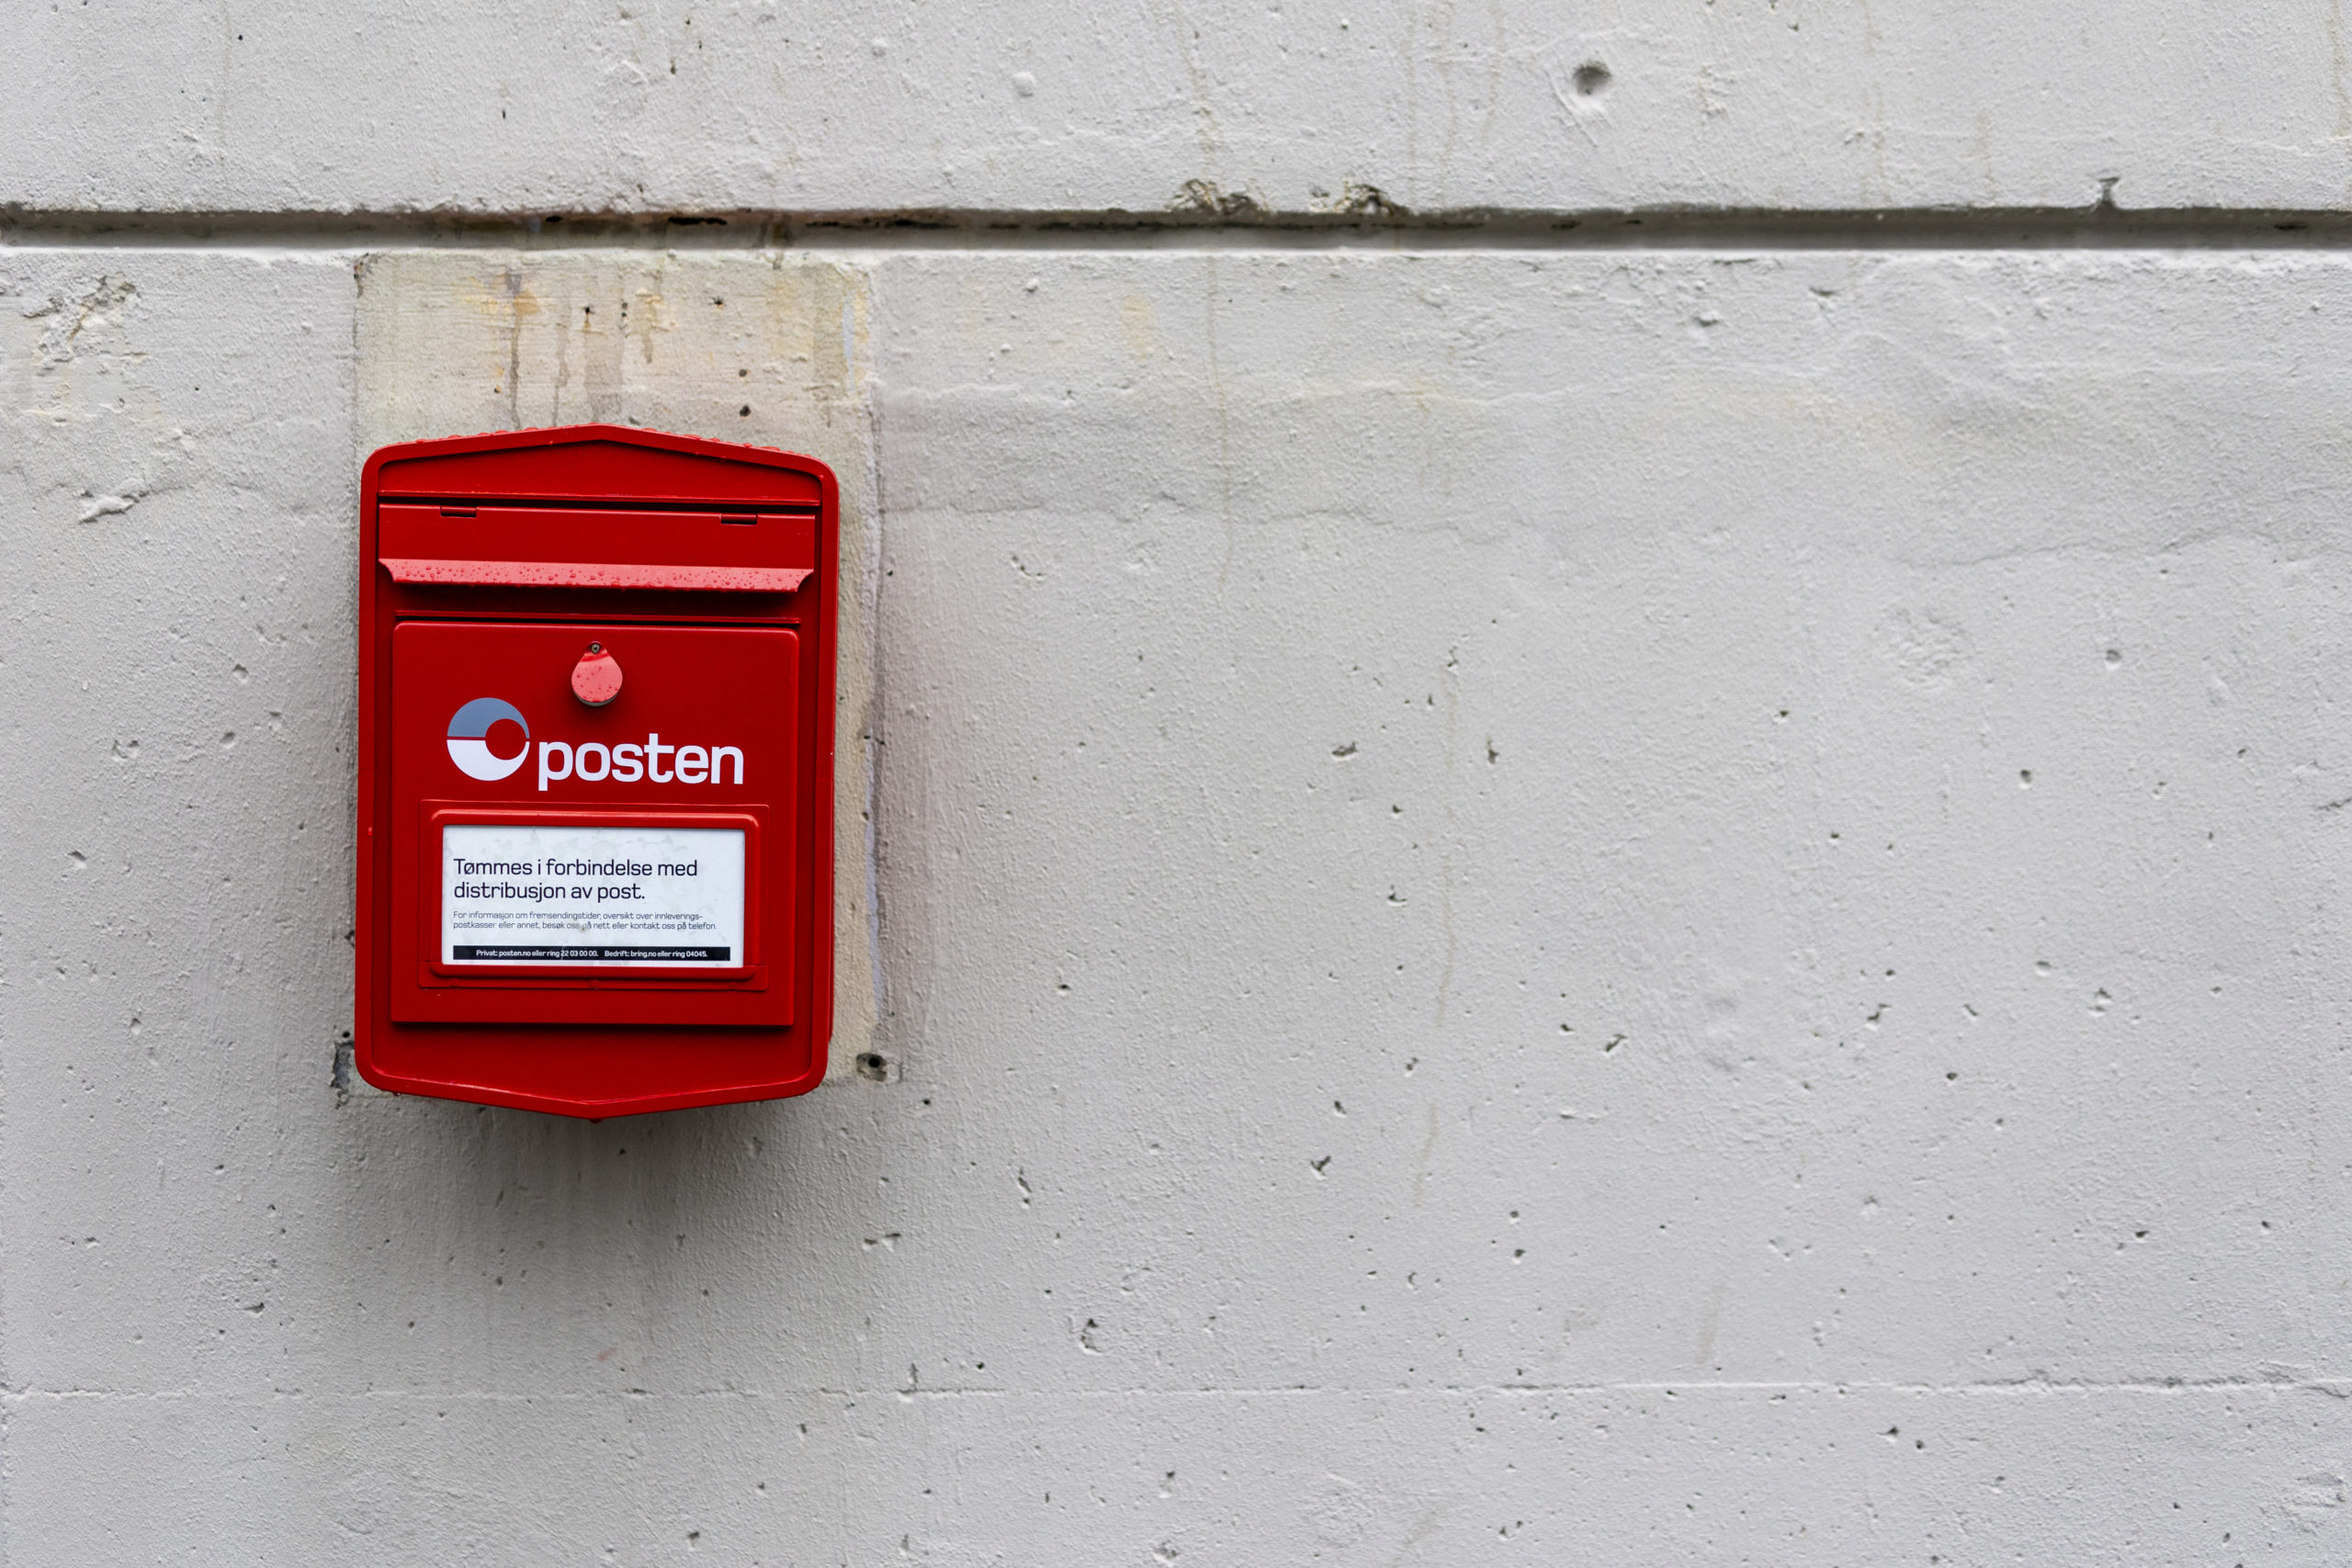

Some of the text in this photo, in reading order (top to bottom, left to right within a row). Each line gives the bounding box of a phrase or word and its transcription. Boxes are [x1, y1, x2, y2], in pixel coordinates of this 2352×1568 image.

[538, 733, 743, 791] posten
[453, 858, 697, 876] Tømmes i forbindelse med
[454, 882, 645, 903] distribusjon av post.
[453, 911, 468, 919] For
[469, 911, 514, 921] informasjon
[529, 911, 602, 921] fremsendingstider,
[604, 912, 634, 920] oversikt
[654, 912, 703, 922] innleverings-
[453, 921, 496, 931] postkasser
[499, 921, 514, 930] eller
[516, 921, 541, 931] annet,
[543, 921, 565, 930] besøk
[613, 921, 629, 930] eller
[630, 921, 660, 930] kontakt
[677, 921, 687, 931] på
[499, 950, 531, 958] posten.no
[547, 950, 560, 958] ring
[630, 950, 656, 958] bring.no
